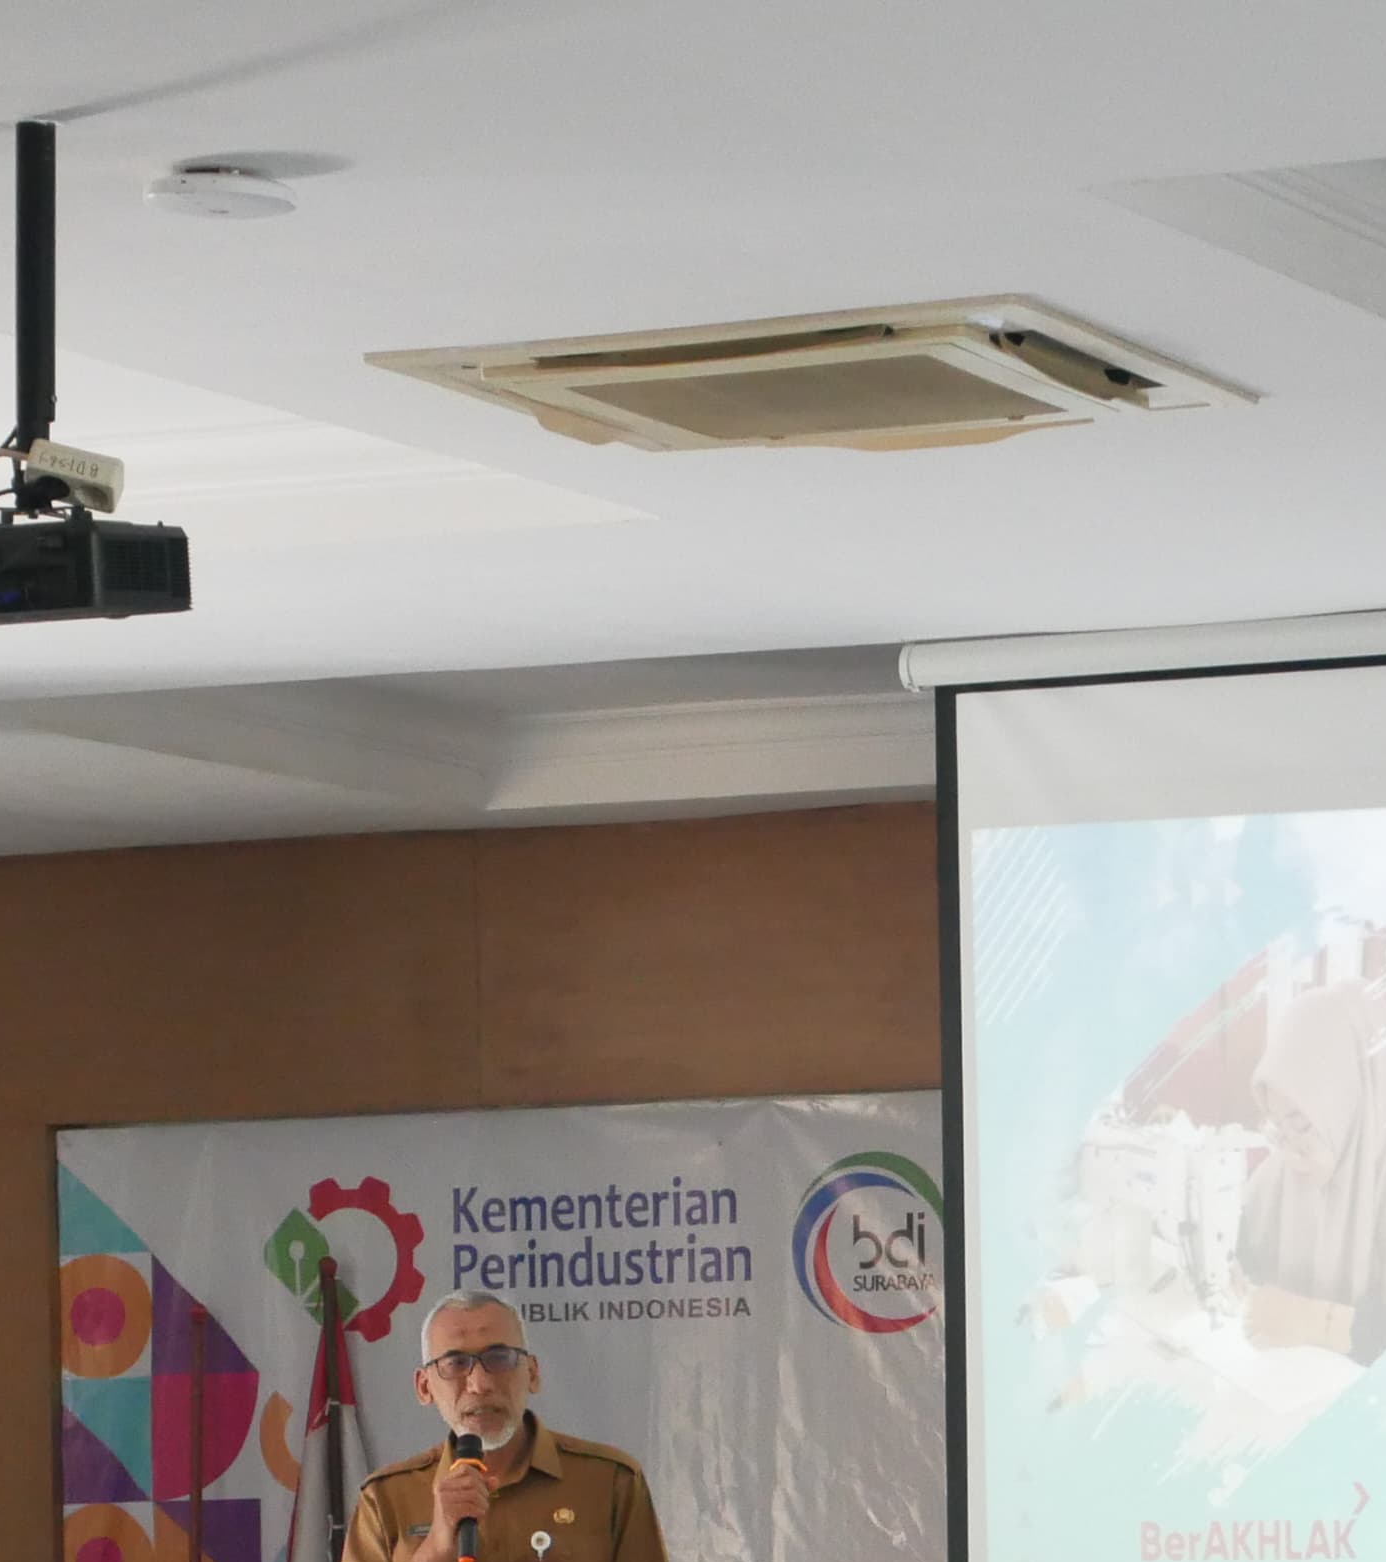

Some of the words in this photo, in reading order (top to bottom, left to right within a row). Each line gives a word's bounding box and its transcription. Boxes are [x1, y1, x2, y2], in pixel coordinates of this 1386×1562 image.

[453, 1176, 737, 1233] Kementerian
[453, 1233, 752, 1290] Perindustrian
[853, 1212, 925, 1270] bdi
[853, 1274, 935, 1292] SURABAYA
[520, 1302, 589, 1322] BLIK
[599, 1297, 751, 1320] INDONESIA
[1140, 1519, 1357, 1562] BerAKHLAK
